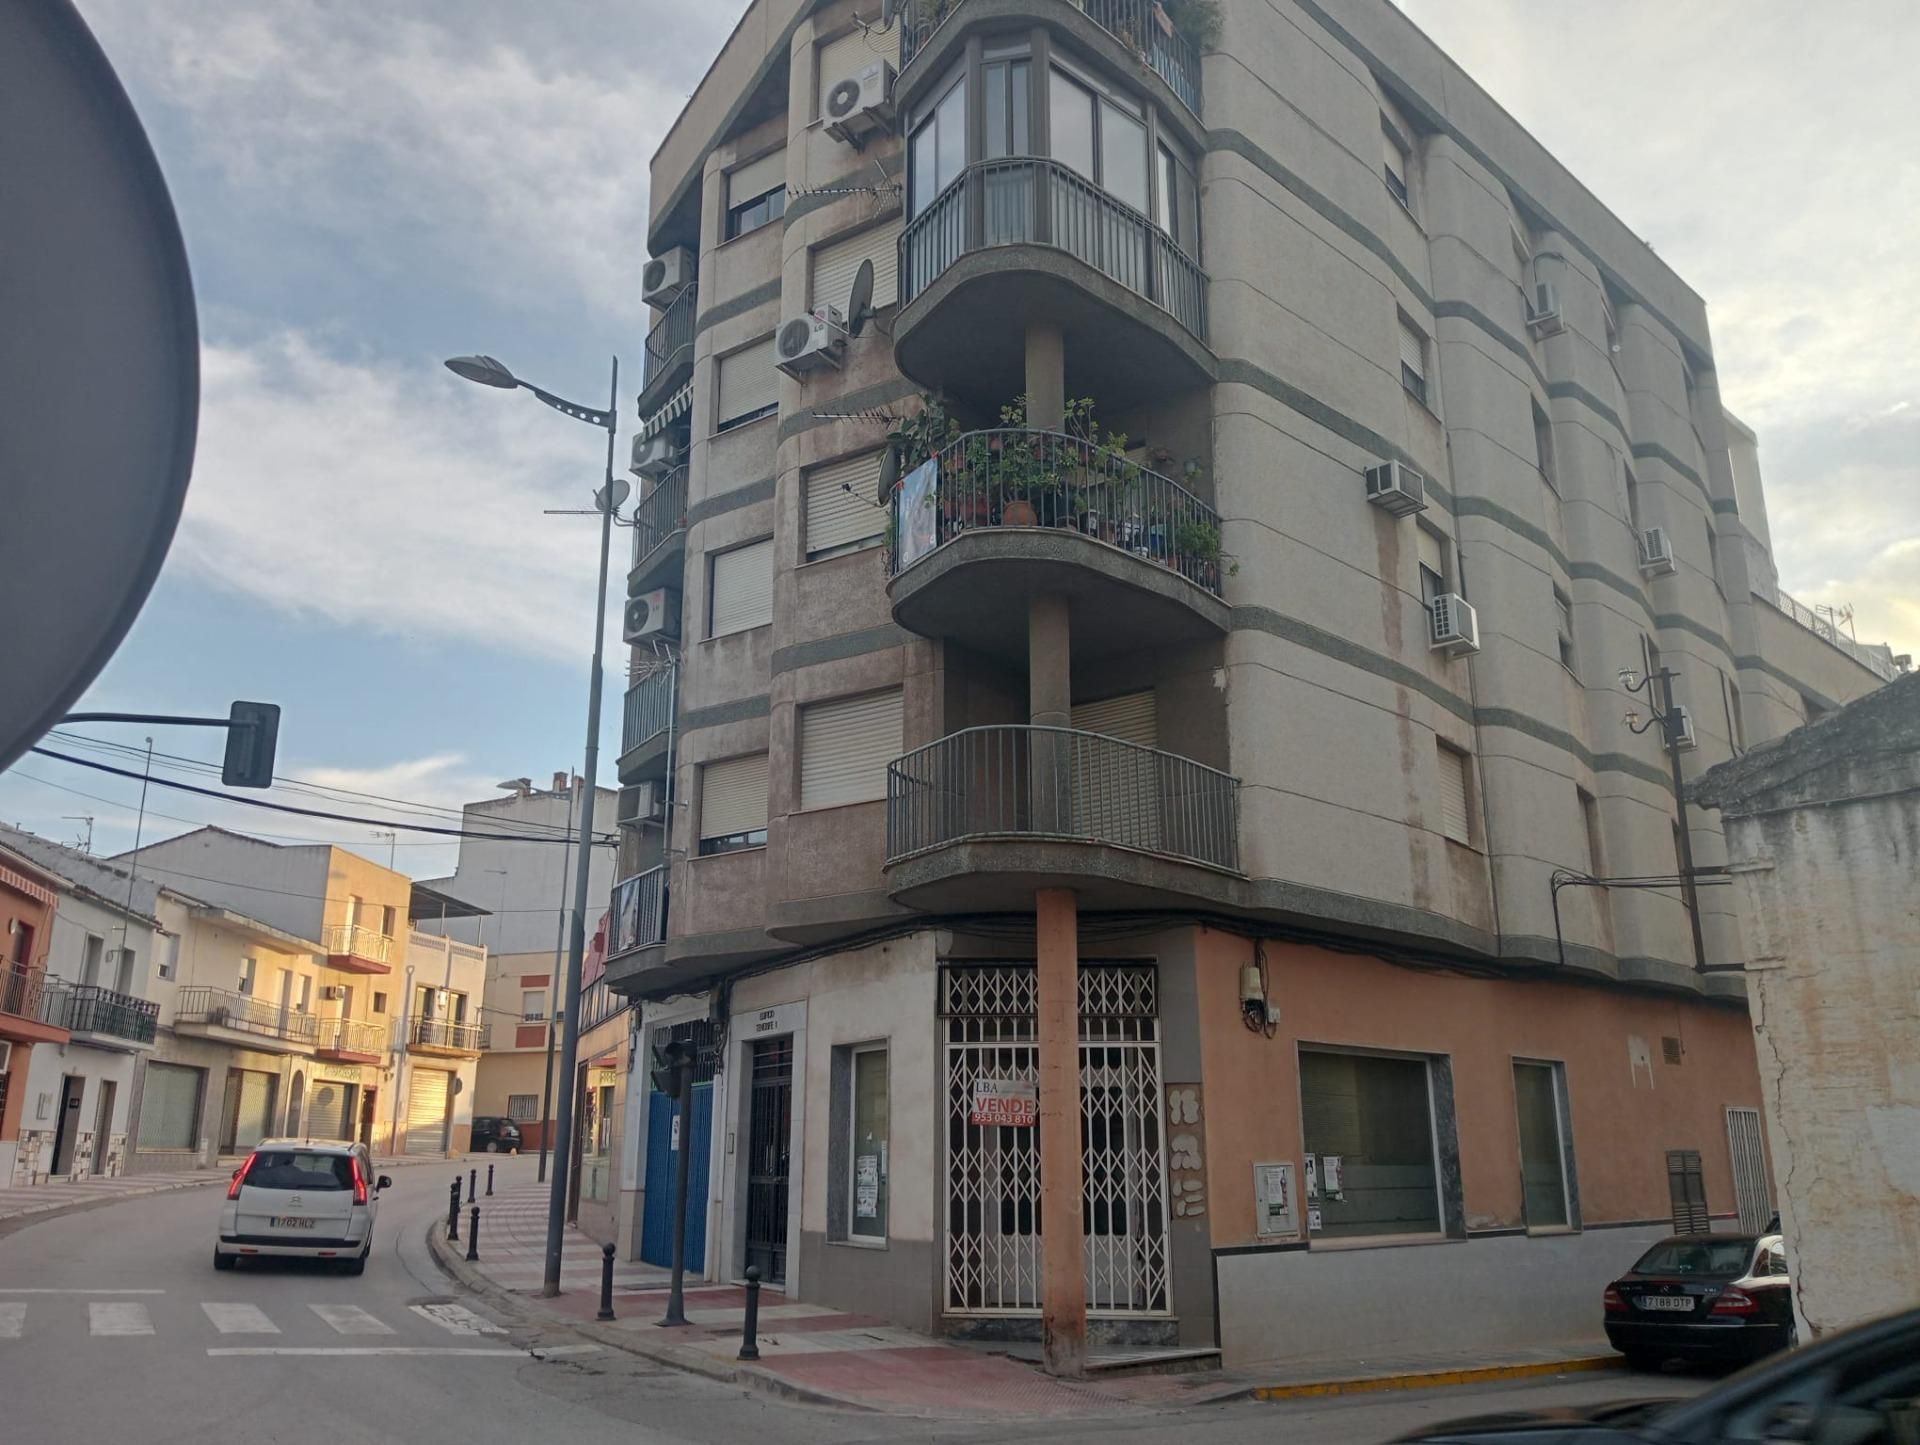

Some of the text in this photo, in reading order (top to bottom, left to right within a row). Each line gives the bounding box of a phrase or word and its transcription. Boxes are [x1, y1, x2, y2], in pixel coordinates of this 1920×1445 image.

[814, 324, 824, 332] LG
[976, 1081, 998, 1093] LBA
[976, 1097, 1033, 1113] VENDE
[975, 1113, 1034, 1124] 953 043 810
